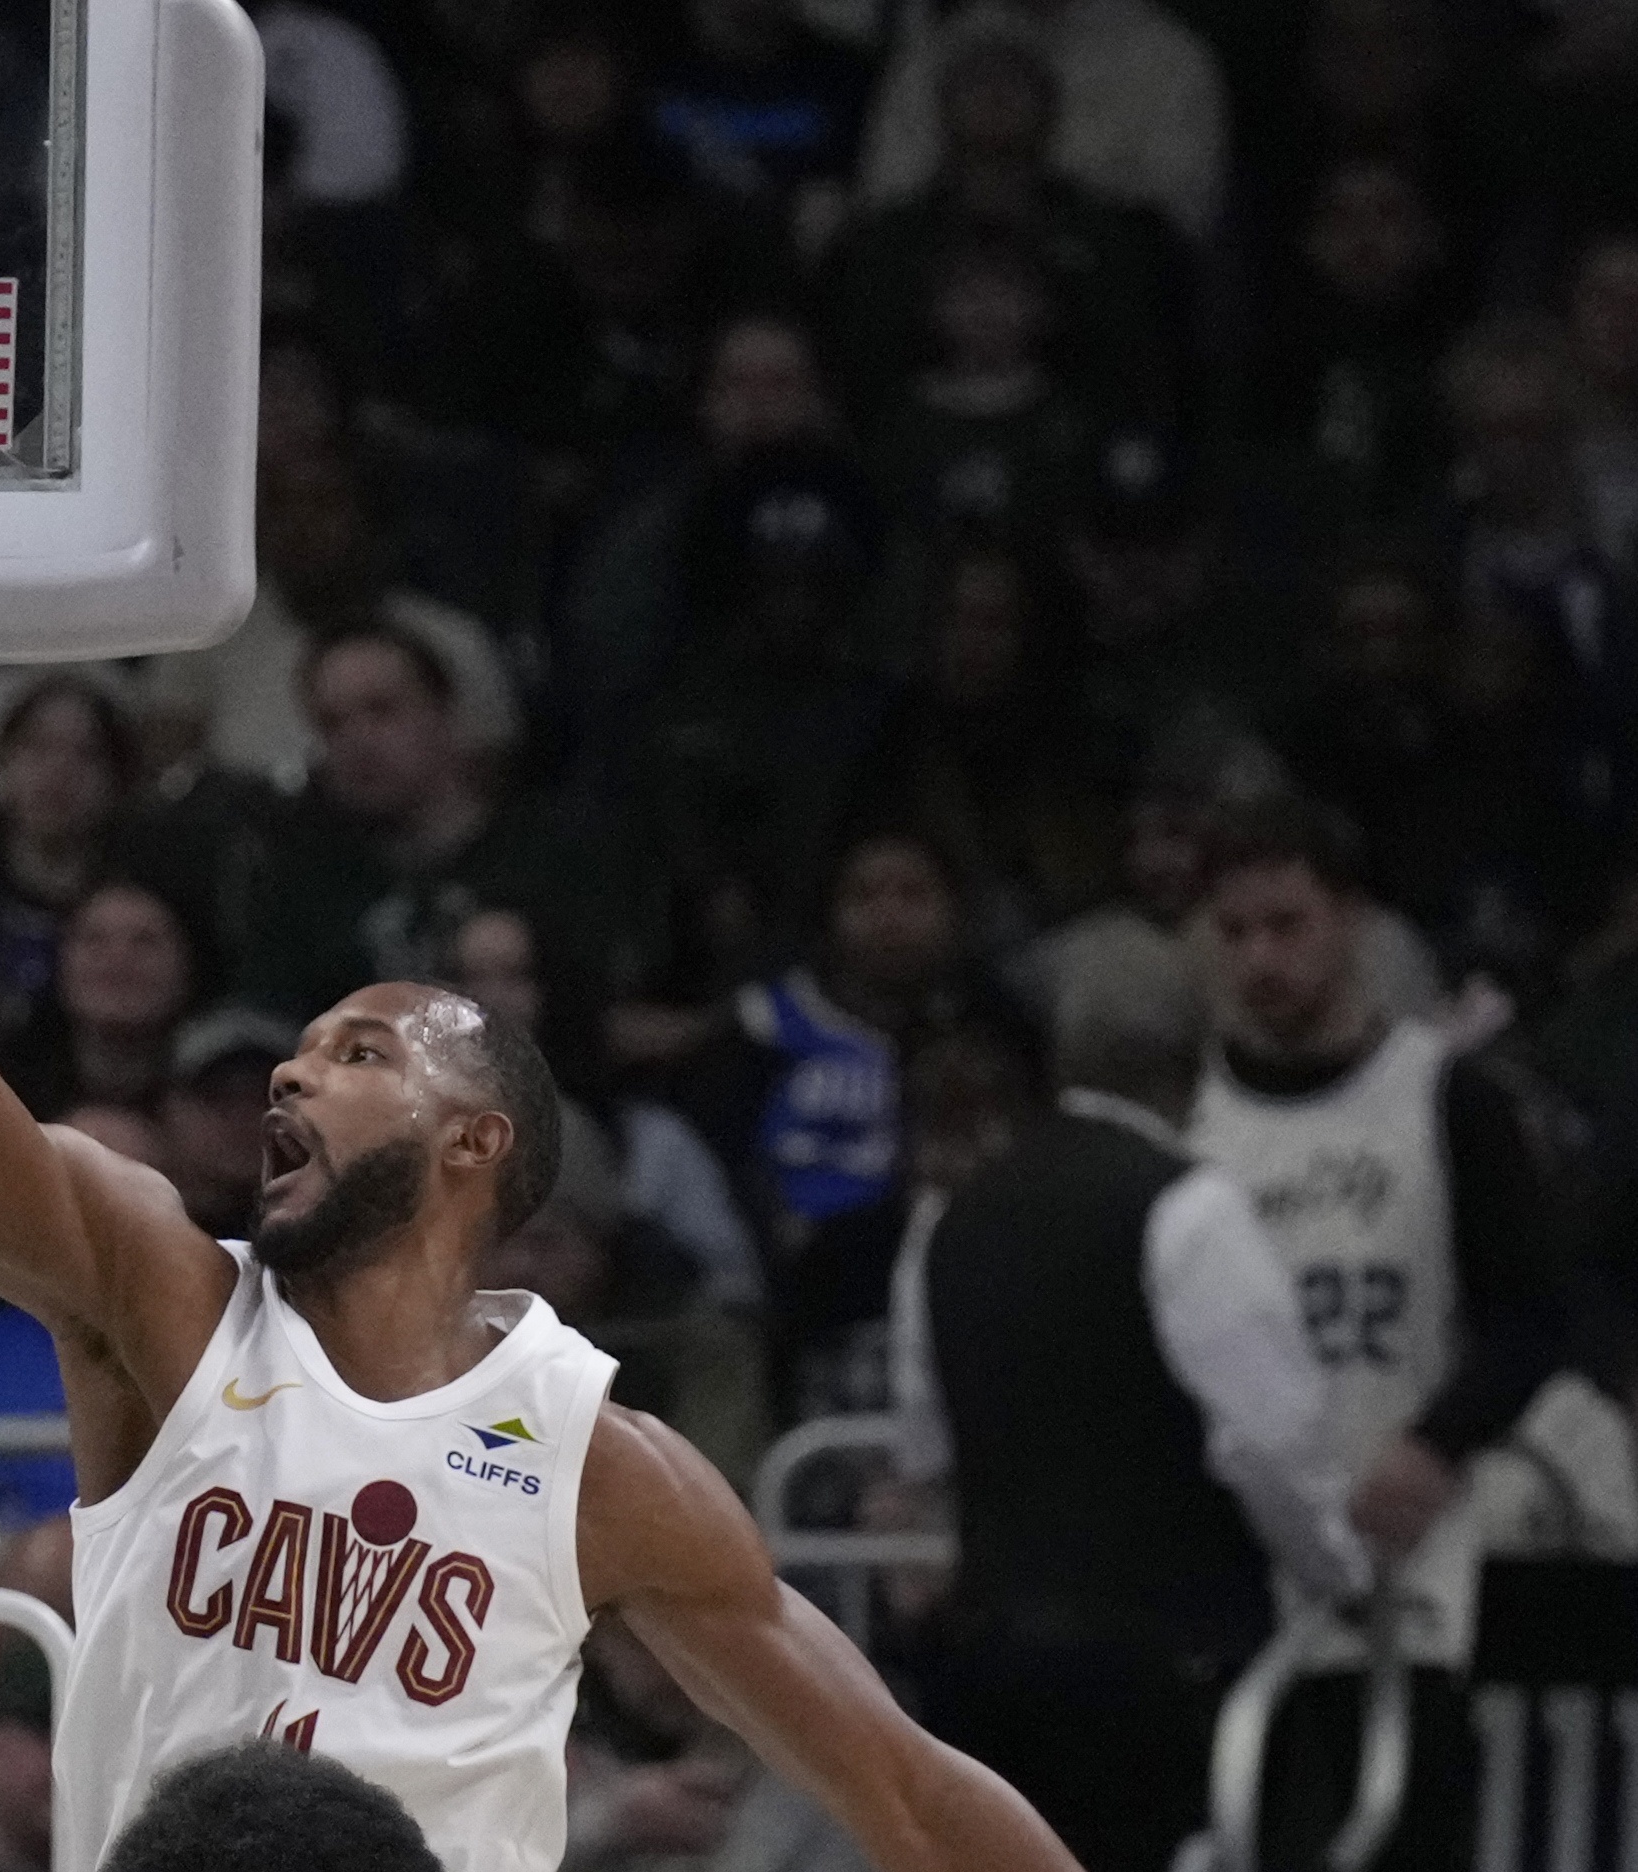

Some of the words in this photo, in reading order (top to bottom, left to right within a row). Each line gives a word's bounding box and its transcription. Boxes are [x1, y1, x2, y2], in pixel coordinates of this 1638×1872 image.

[1296, 1258, 1411, 1374] 22
[446, 1450, 542, 1496] CLIFFS
[166, 1484, 495, 1707] CAVS
